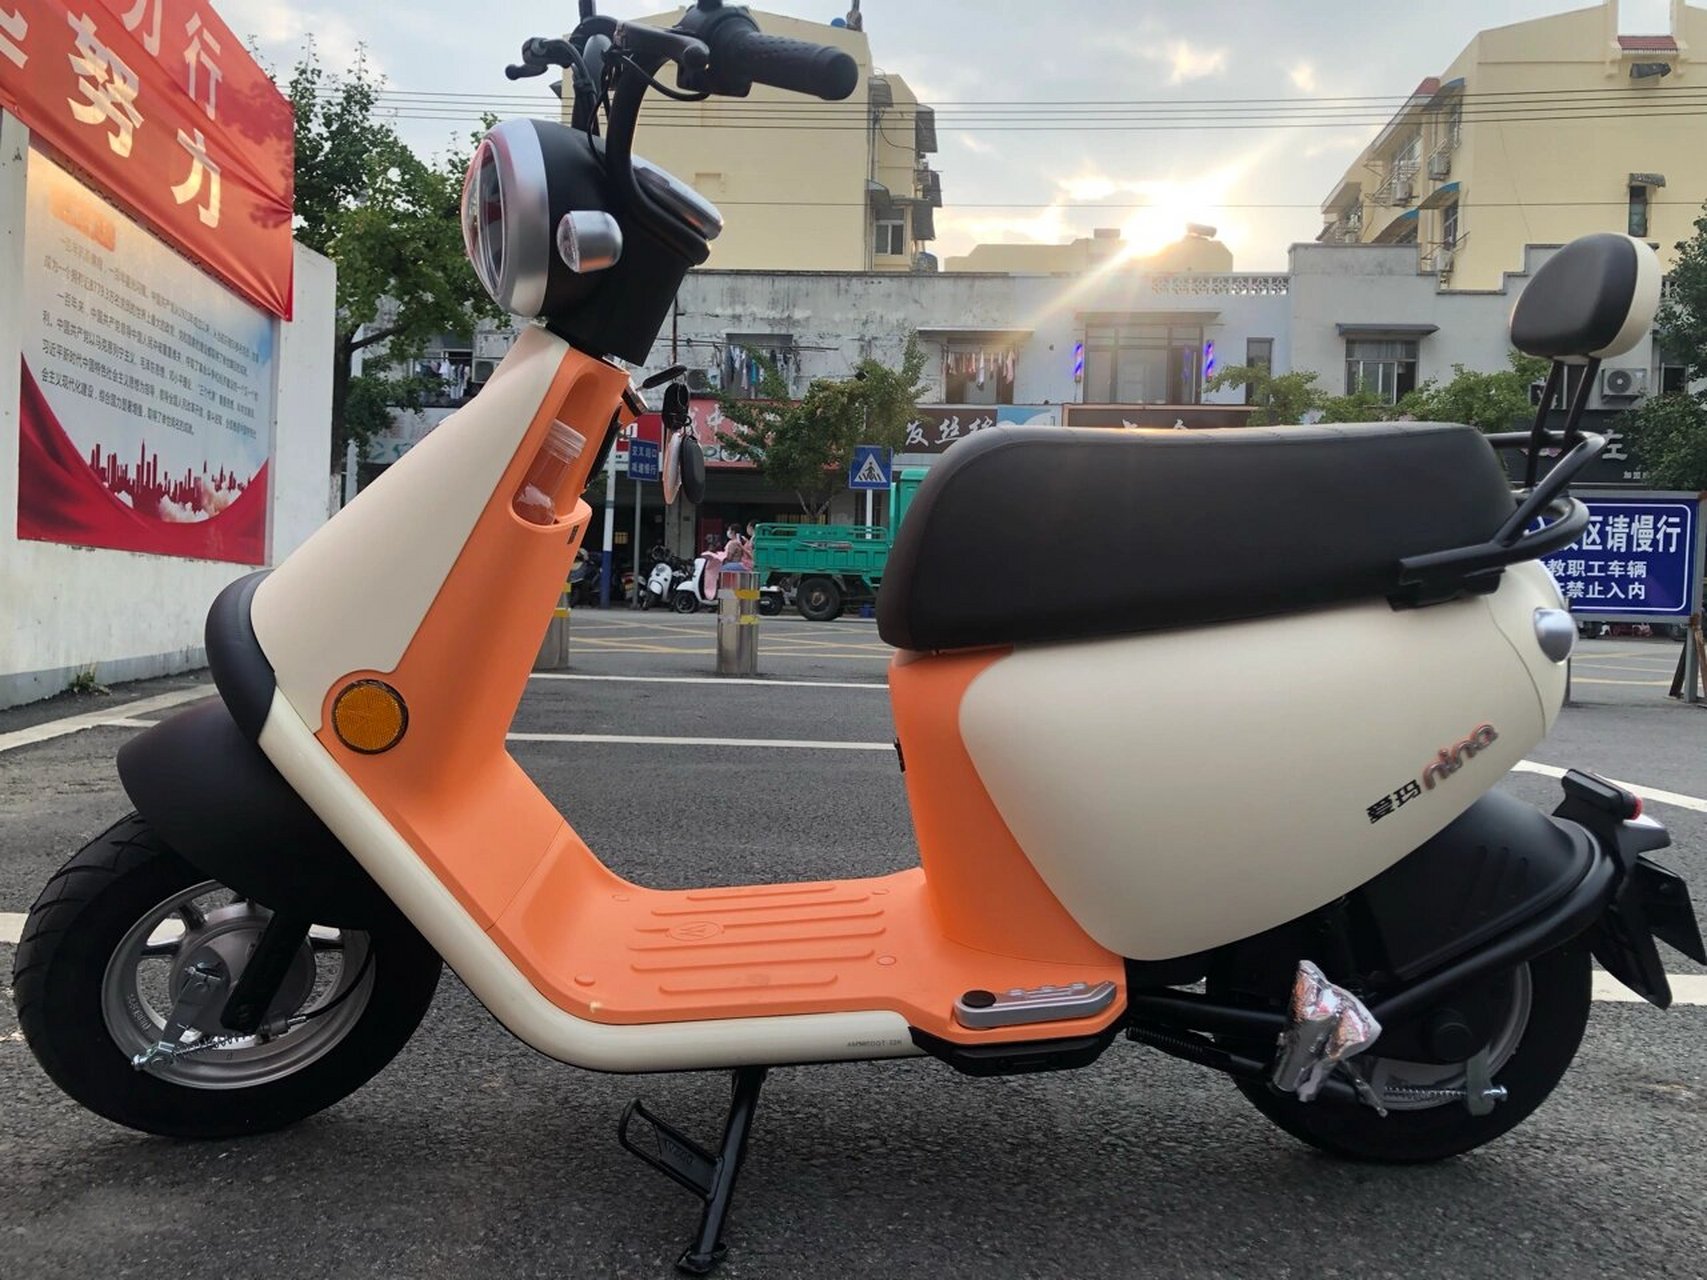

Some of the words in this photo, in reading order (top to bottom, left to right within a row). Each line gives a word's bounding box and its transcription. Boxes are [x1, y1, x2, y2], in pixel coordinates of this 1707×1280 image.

[1537, 515, 1682, 553] 区请慢行
[1542, 560, 1647, 578] 教职工车辆
[1366, 779, 1422, 824] 爱玛
